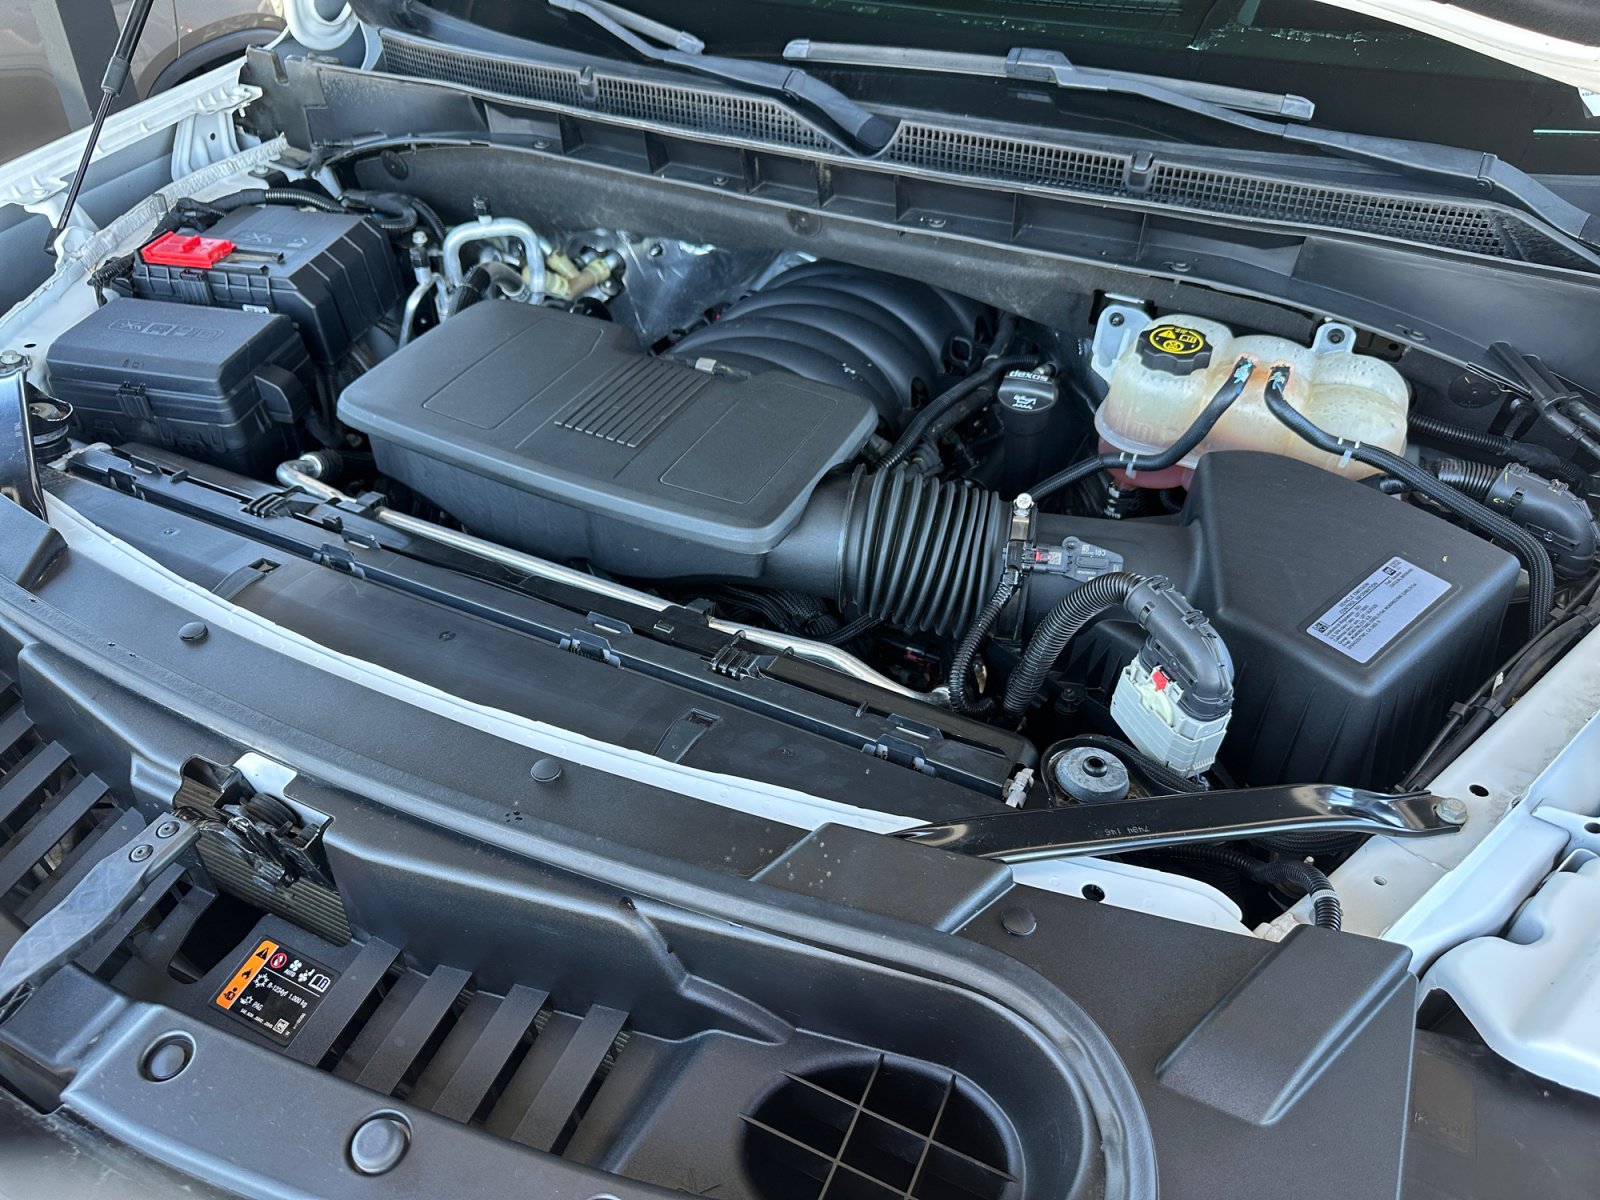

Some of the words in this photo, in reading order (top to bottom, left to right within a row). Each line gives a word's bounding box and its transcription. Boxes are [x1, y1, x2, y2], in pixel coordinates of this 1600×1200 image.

[1009, 369, 1049, 381] dexos
[1338, 599, 1356, 614] CONTROL
[1354, 581, 1378, 600] INFORMATION
[1338, 594, 1354, 607] VEHICLE
[284, 969, 296, 977] AUTO
[267, 982, 289, 997] R-1234yf
[289, 994, 302, 1004] 1.000
[301, 999, 308, 1008] kg
[252, 1001, 264, 1011] PAG
